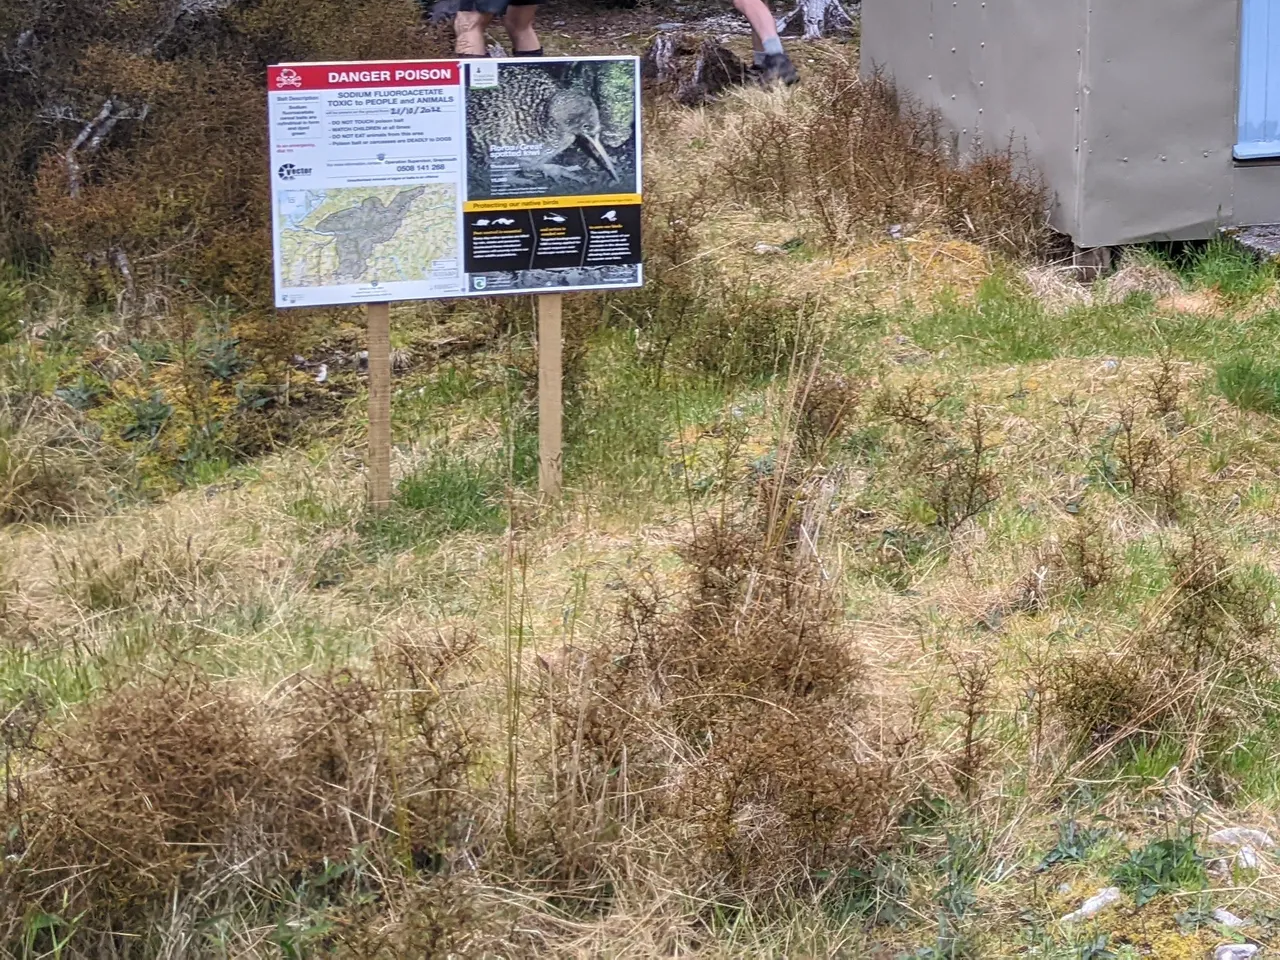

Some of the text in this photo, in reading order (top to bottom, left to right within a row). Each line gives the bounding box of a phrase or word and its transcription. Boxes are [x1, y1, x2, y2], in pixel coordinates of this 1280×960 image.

[328, 69, 452, 83] DANGER POISON
[337, 88, 444, 99] SODIUM FLUOROACETATE
[365, 98, 398, 106] PEOPLE
[416, 96, 455, 104] ANIMALS
[489, 150, 523, 159] spotted
[473, 202, 509, 210] Protecting
